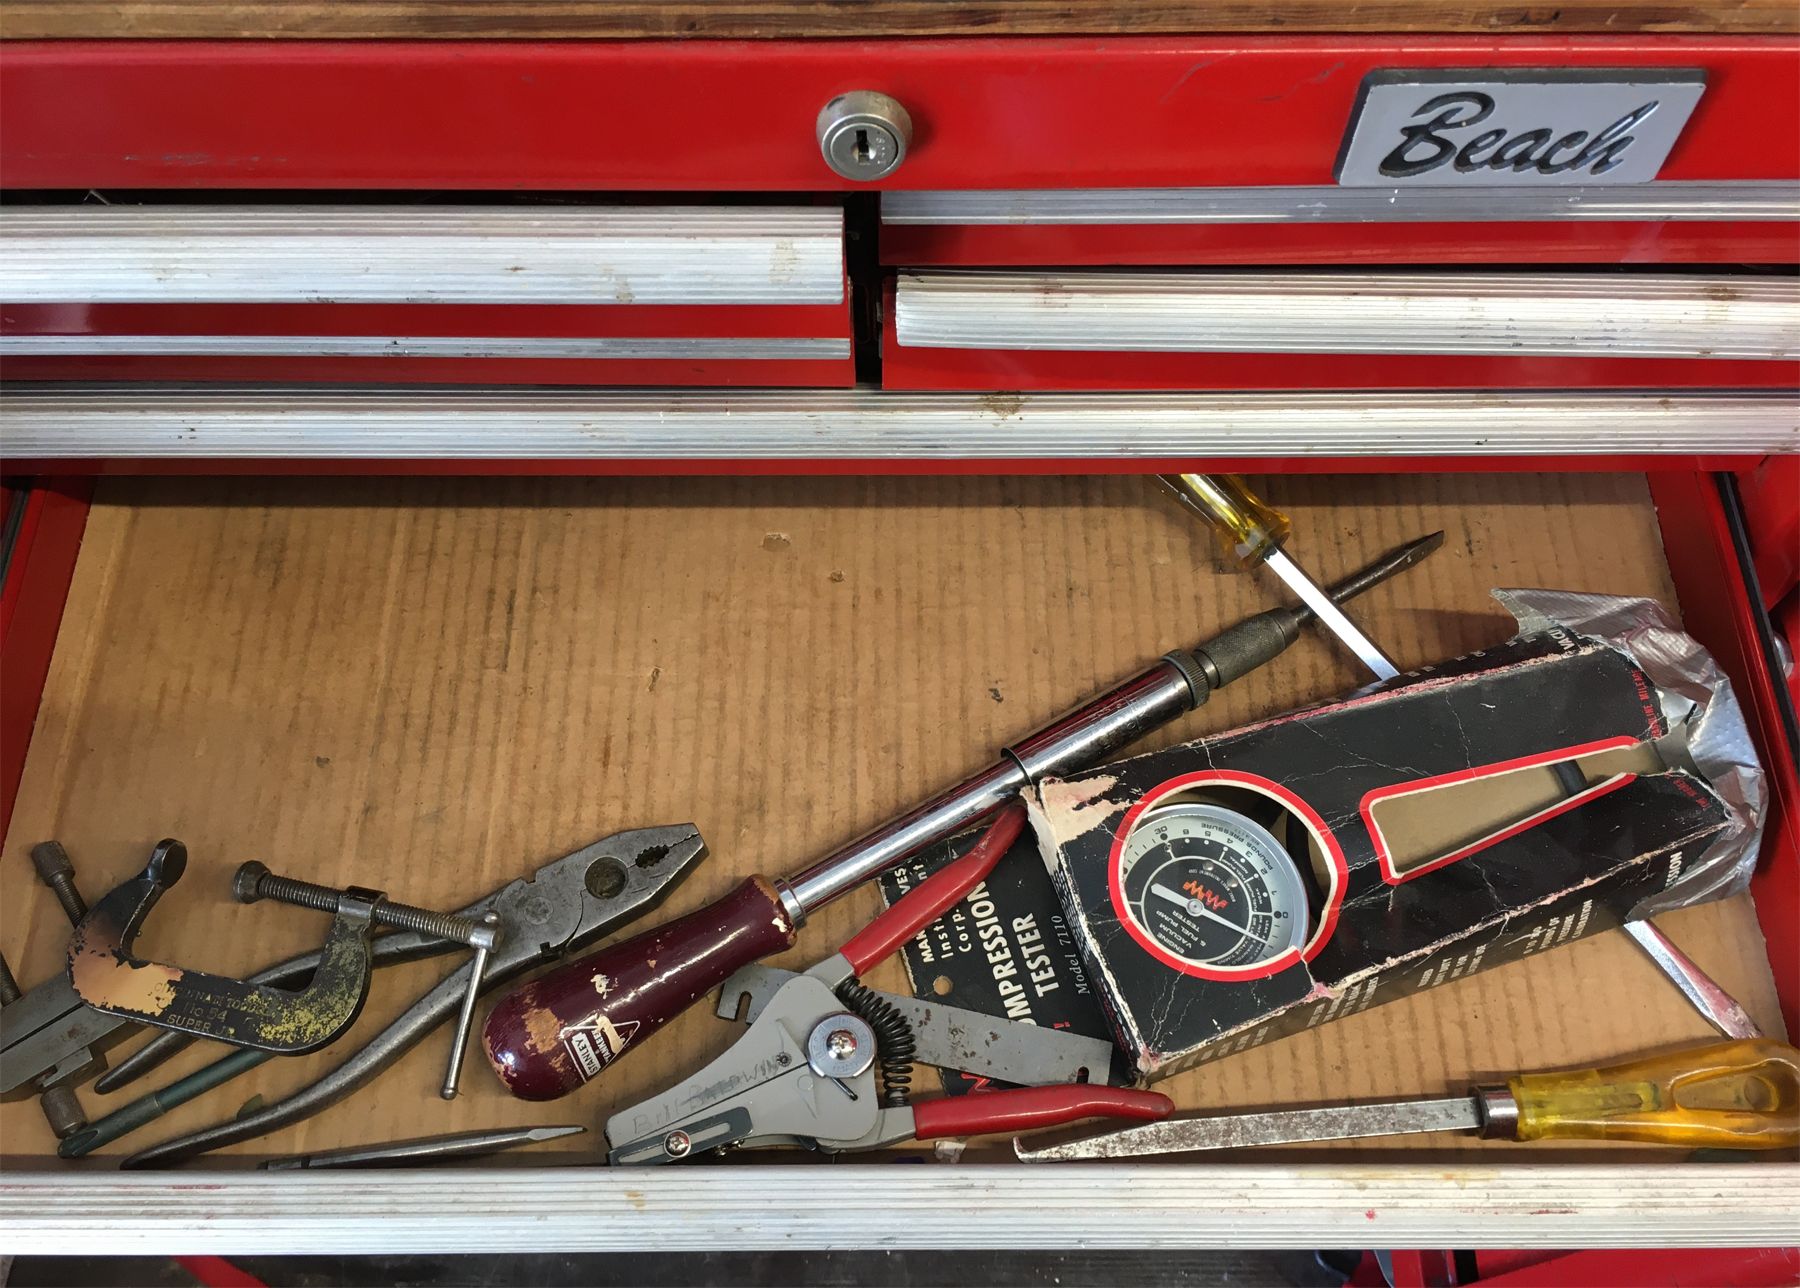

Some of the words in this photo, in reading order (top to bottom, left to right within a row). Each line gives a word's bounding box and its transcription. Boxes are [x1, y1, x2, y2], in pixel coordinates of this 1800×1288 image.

[1378, 91, 1659, 177] Beach
[1201, 822, 1244, 843] PRESSURE
[1246, 842, 1273, 871] POUNDS
[951, 908, 972, 953] Corp.
[1051, 915, 1071, 946] 7110
[1156, 910, 1179, 928] PUMP
[1172, 910, 1200, 932] TESTER
[1156, 932, 1185, 954] ENGINE
[1159, 922, 1192, 949] VACUUM
[1180, 925, 1199, 942] FUEL
[1012, 912, 1060, 998] TESTER
[1064, 953, 1090, 995] Model
[166, 1014, 212, 1035] SUPER
[575, 1039, 598, 1074] STANLEY
